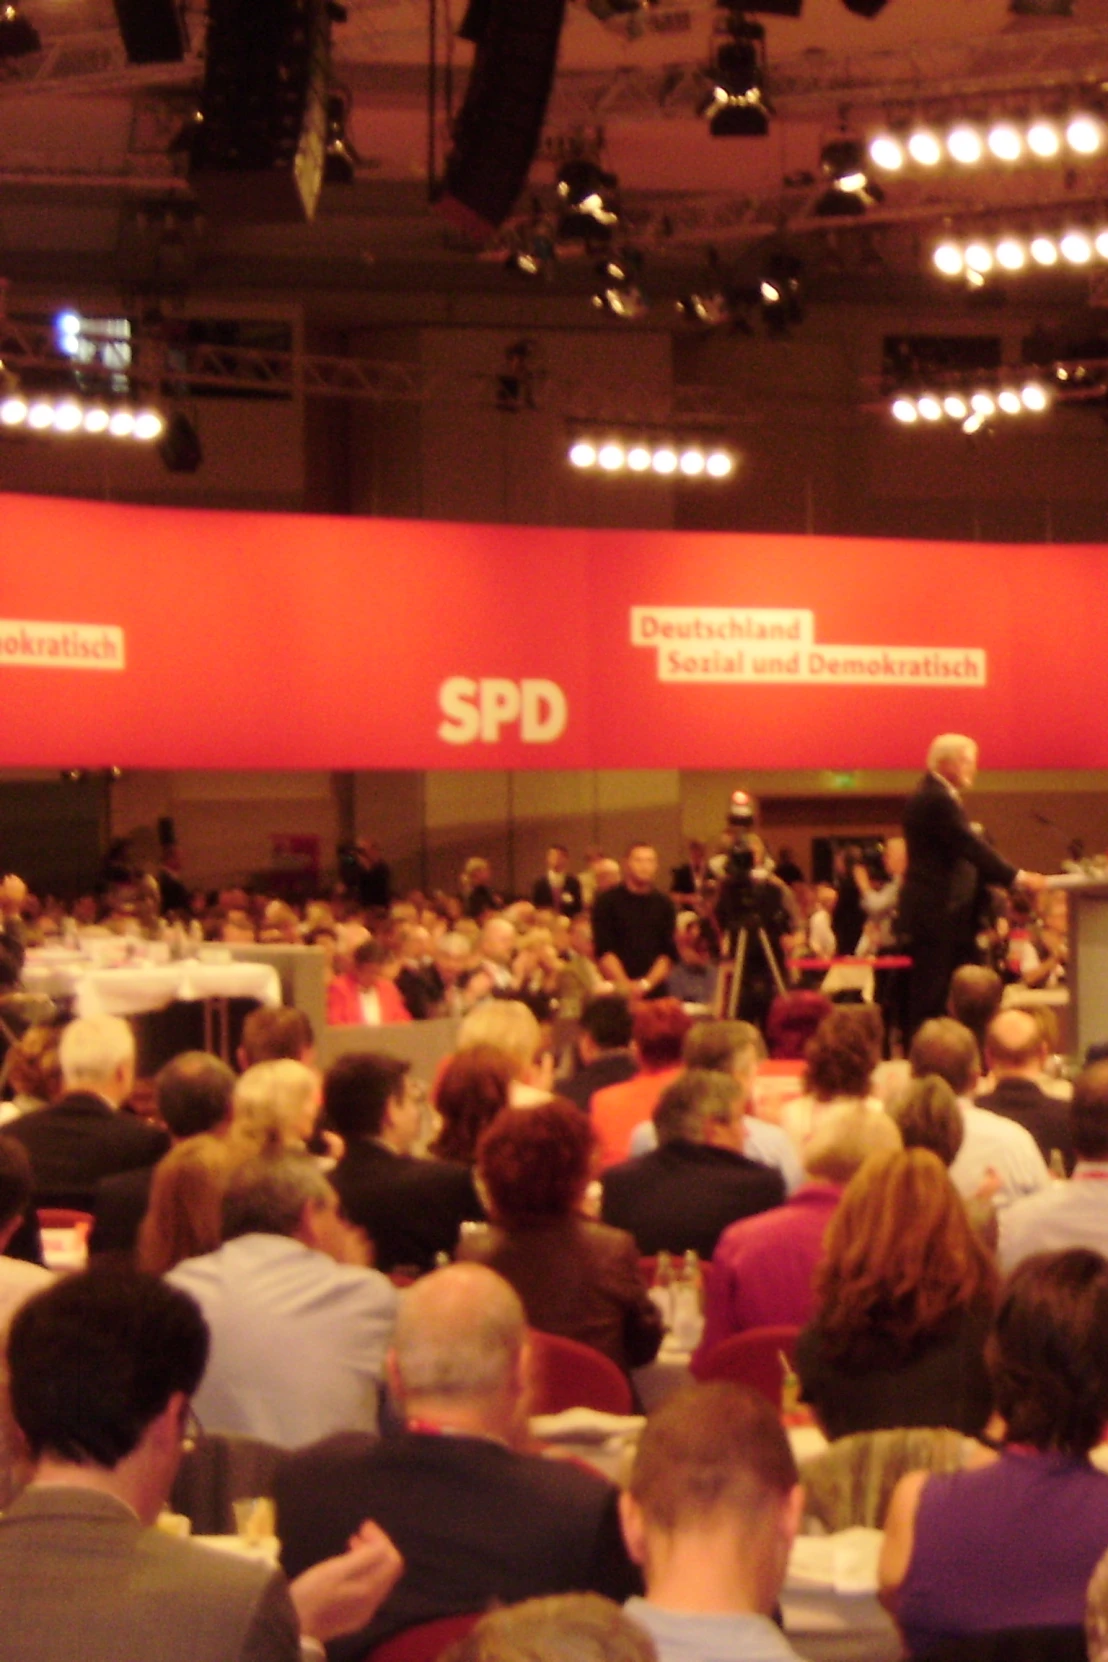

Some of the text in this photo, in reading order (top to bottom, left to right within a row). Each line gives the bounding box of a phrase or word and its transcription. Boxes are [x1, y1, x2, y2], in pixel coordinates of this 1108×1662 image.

[0, 625, 117, 659] okratisch
[640, 613, 802, 642] Deutschland
[667, 648, 979, 679] Sozial und Demokratisch
[437, 676, 568, 745] SPD
